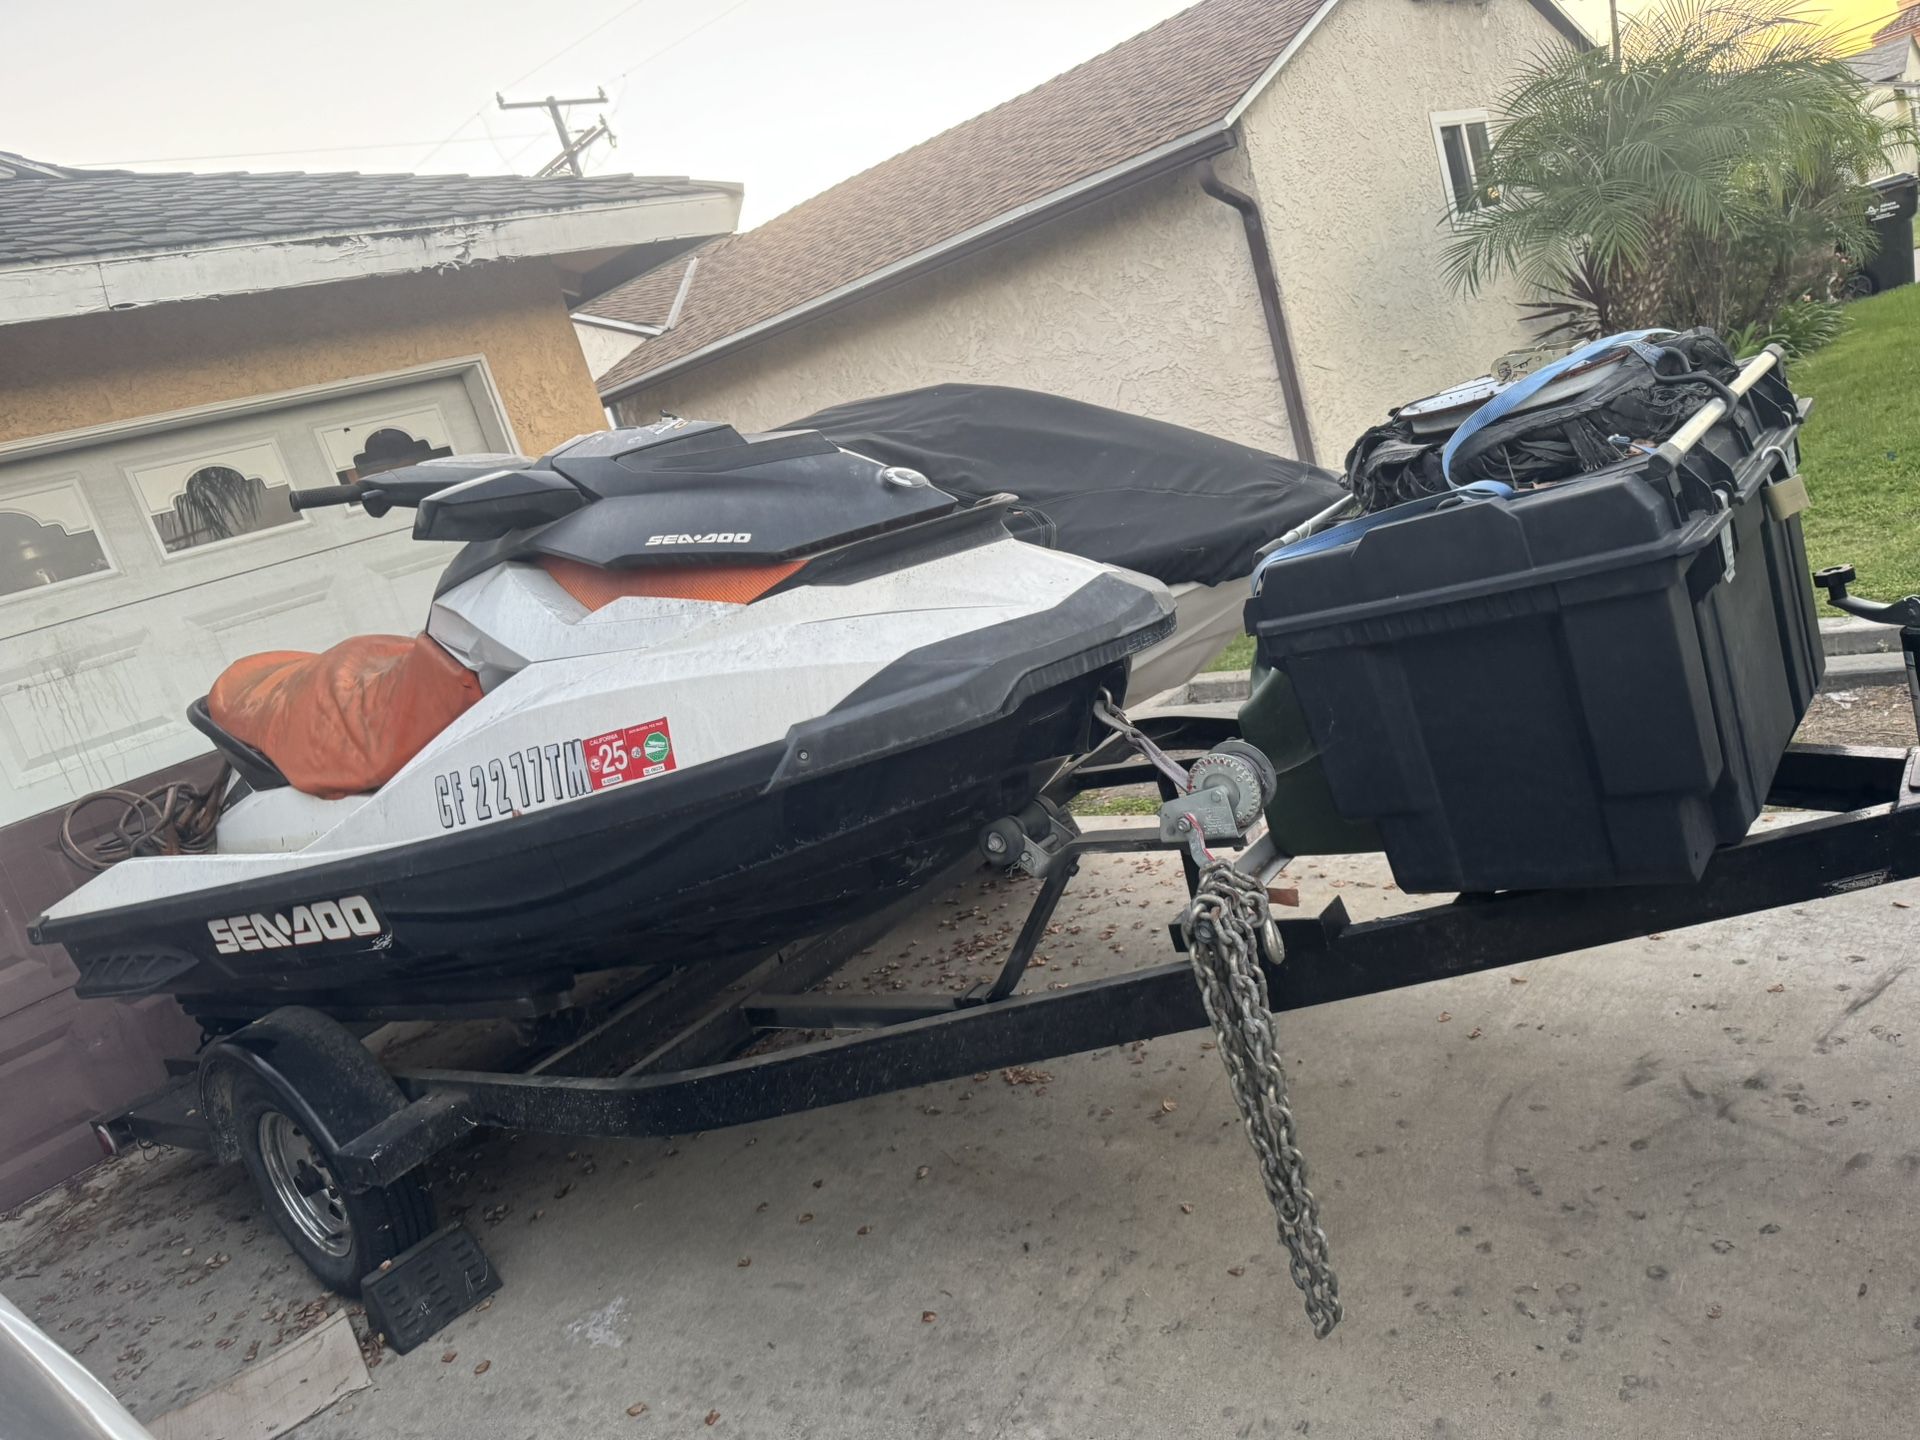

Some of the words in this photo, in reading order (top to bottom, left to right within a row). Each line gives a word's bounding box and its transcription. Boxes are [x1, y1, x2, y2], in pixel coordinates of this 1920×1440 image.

[589, 733, 619, 746] CALIFORNIA
[598, 739, 628, 775] 25
[434, 770, 466, 829] CF
